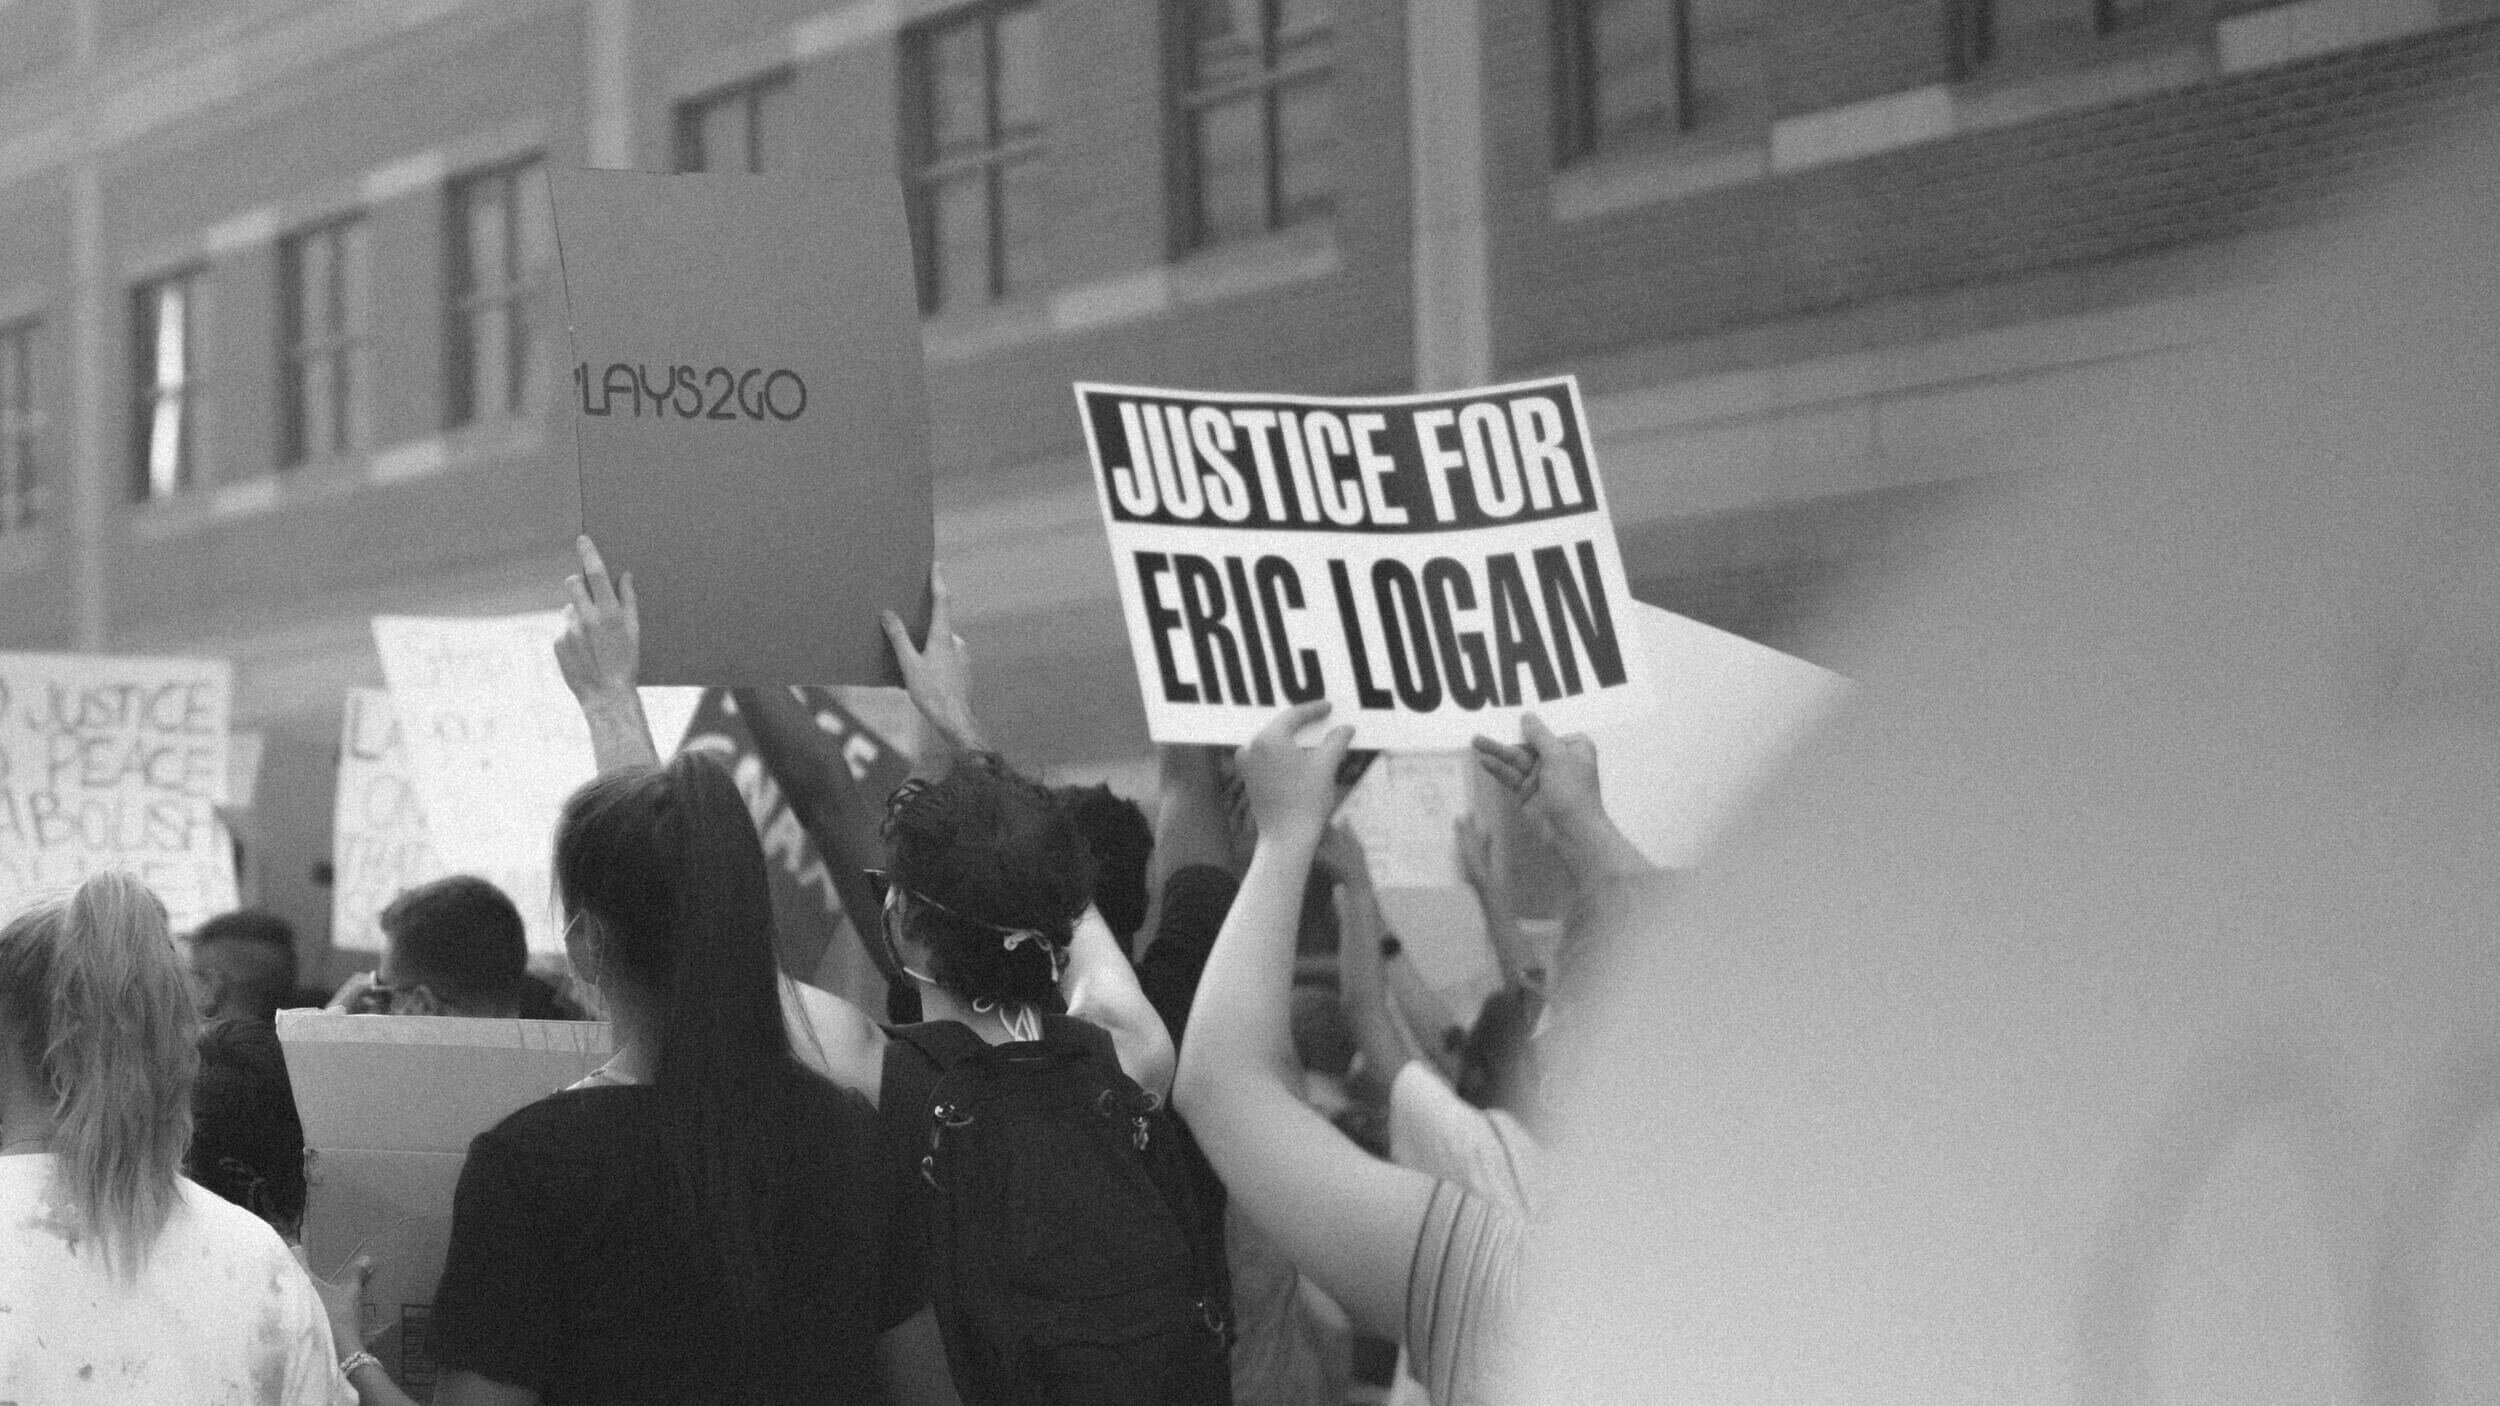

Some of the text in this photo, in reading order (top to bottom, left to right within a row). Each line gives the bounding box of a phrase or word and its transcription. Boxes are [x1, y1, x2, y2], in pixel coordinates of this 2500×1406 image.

[573, 361, 807, 421] LAYS2GO
[1112, 396, 1583, 525] JUSTICE FOR
[1131, 539, 1629, 713] ERIC LOGAN
[24, 678, 216, 738] JUSTICE
[47, 731, 216, 798] PEACE
